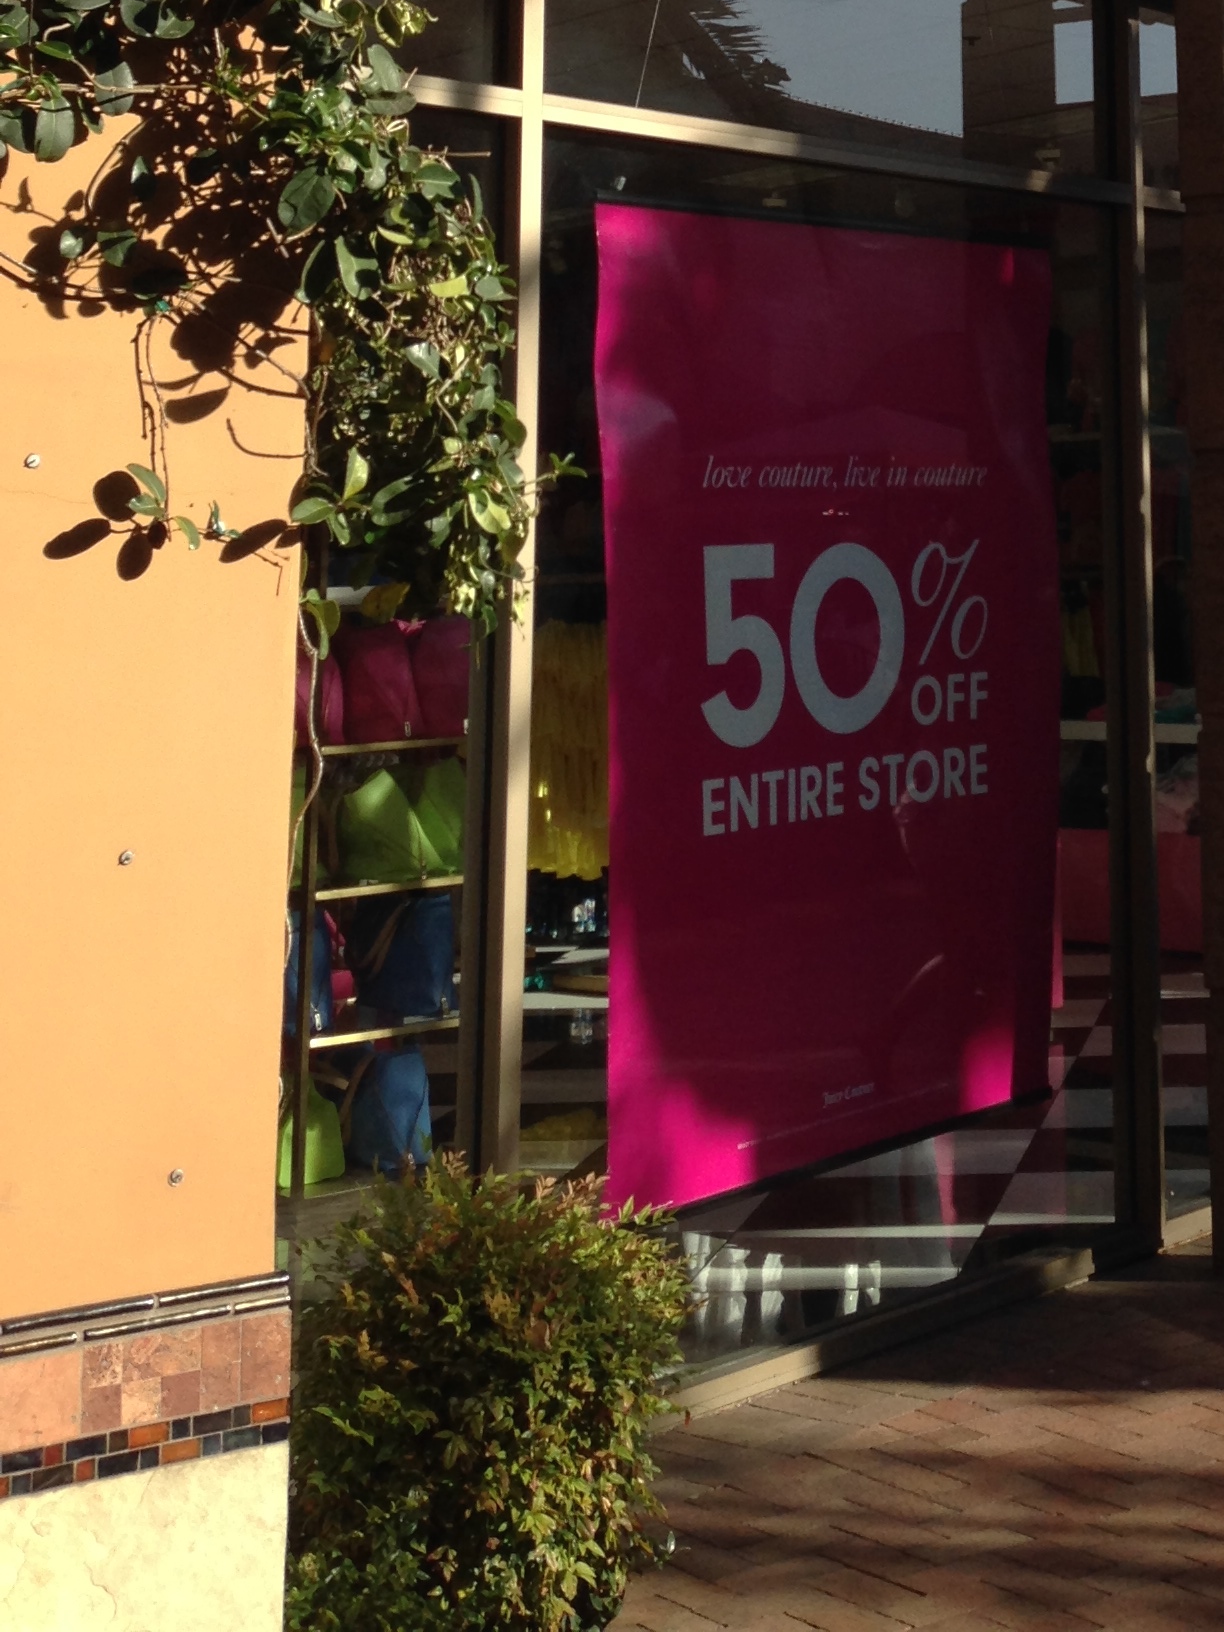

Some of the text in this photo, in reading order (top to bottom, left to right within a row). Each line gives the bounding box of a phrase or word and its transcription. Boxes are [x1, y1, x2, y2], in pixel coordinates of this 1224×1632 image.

[702, 455, 988, 491] love couture, live in couture
[911, 671, 989, 726] OFF
[702, 744, 989, 837] ENTIRE STORE
